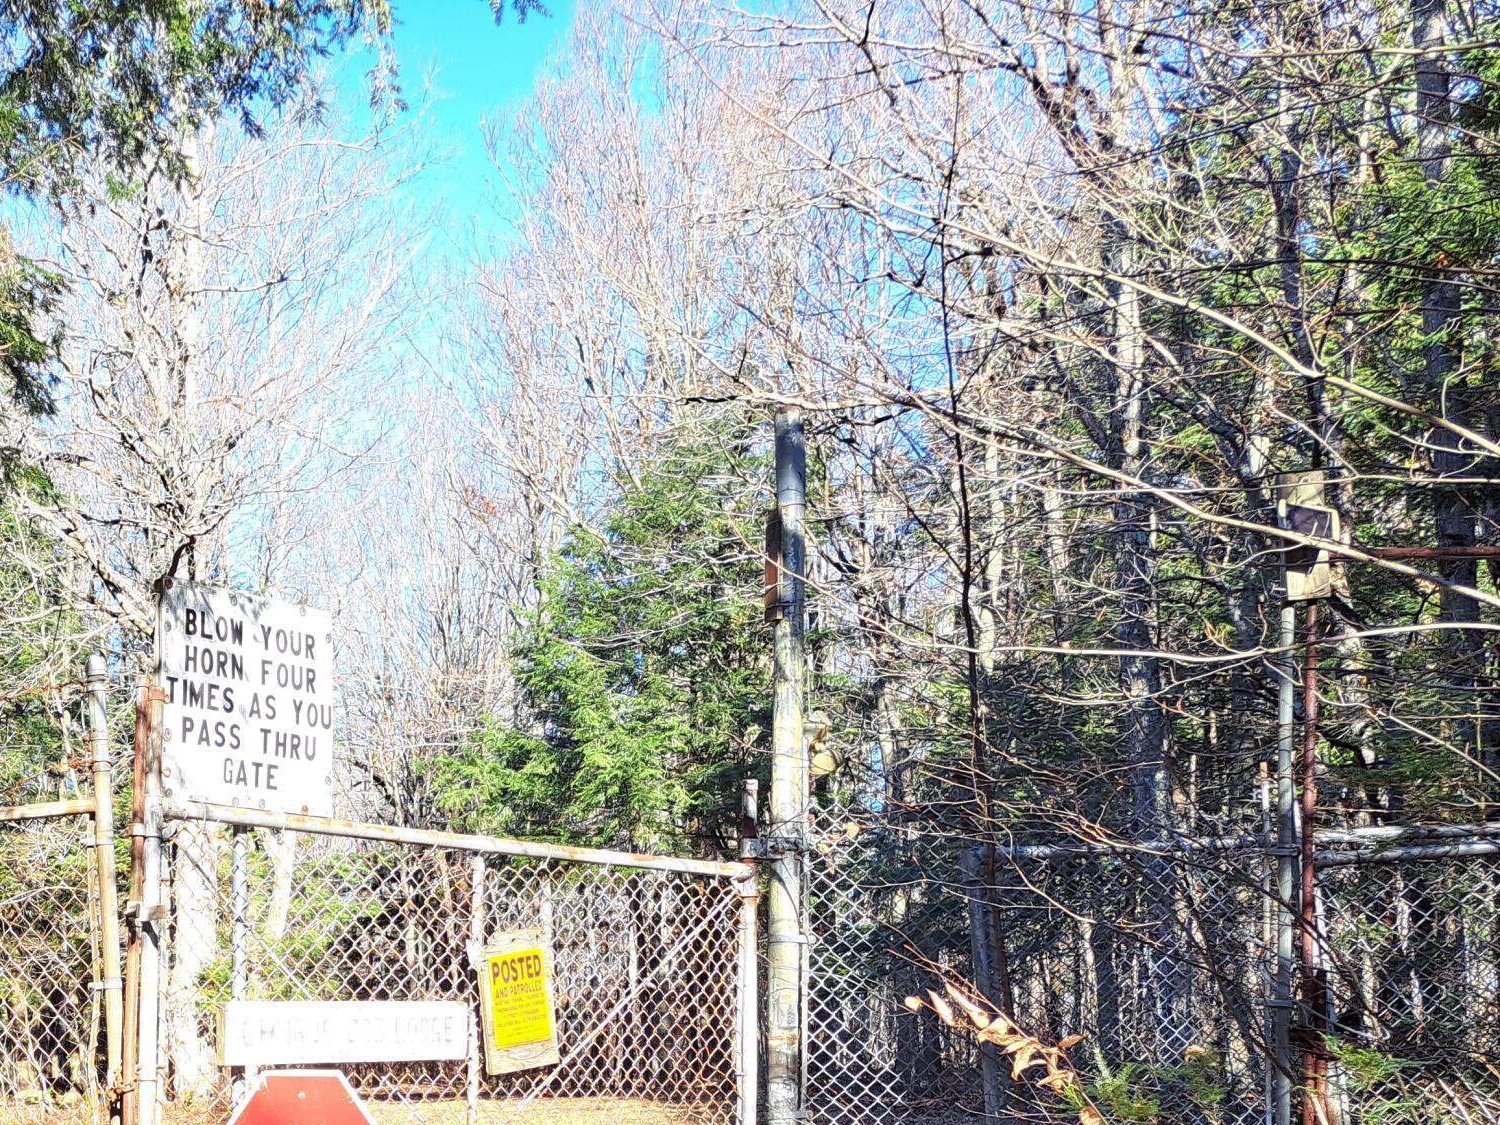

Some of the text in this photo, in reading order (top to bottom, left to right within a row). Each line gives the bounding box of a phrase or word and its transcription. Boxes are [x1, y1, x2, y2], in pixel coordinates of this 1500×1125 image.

[184, 608, 315, 660] BLOW YOUR
[184, 644, 316, 694] HORN FOUR
[166, 676, 332, 730] TIMES AS YOU
[181, 716, 316, 761] PASS THRU
[223, 757, 279, 790] GATE
[491, 954, 542, 985] POSTED
[495, 987, 509, 999] AND
[509, 980, 542, 997] PATROLLED
